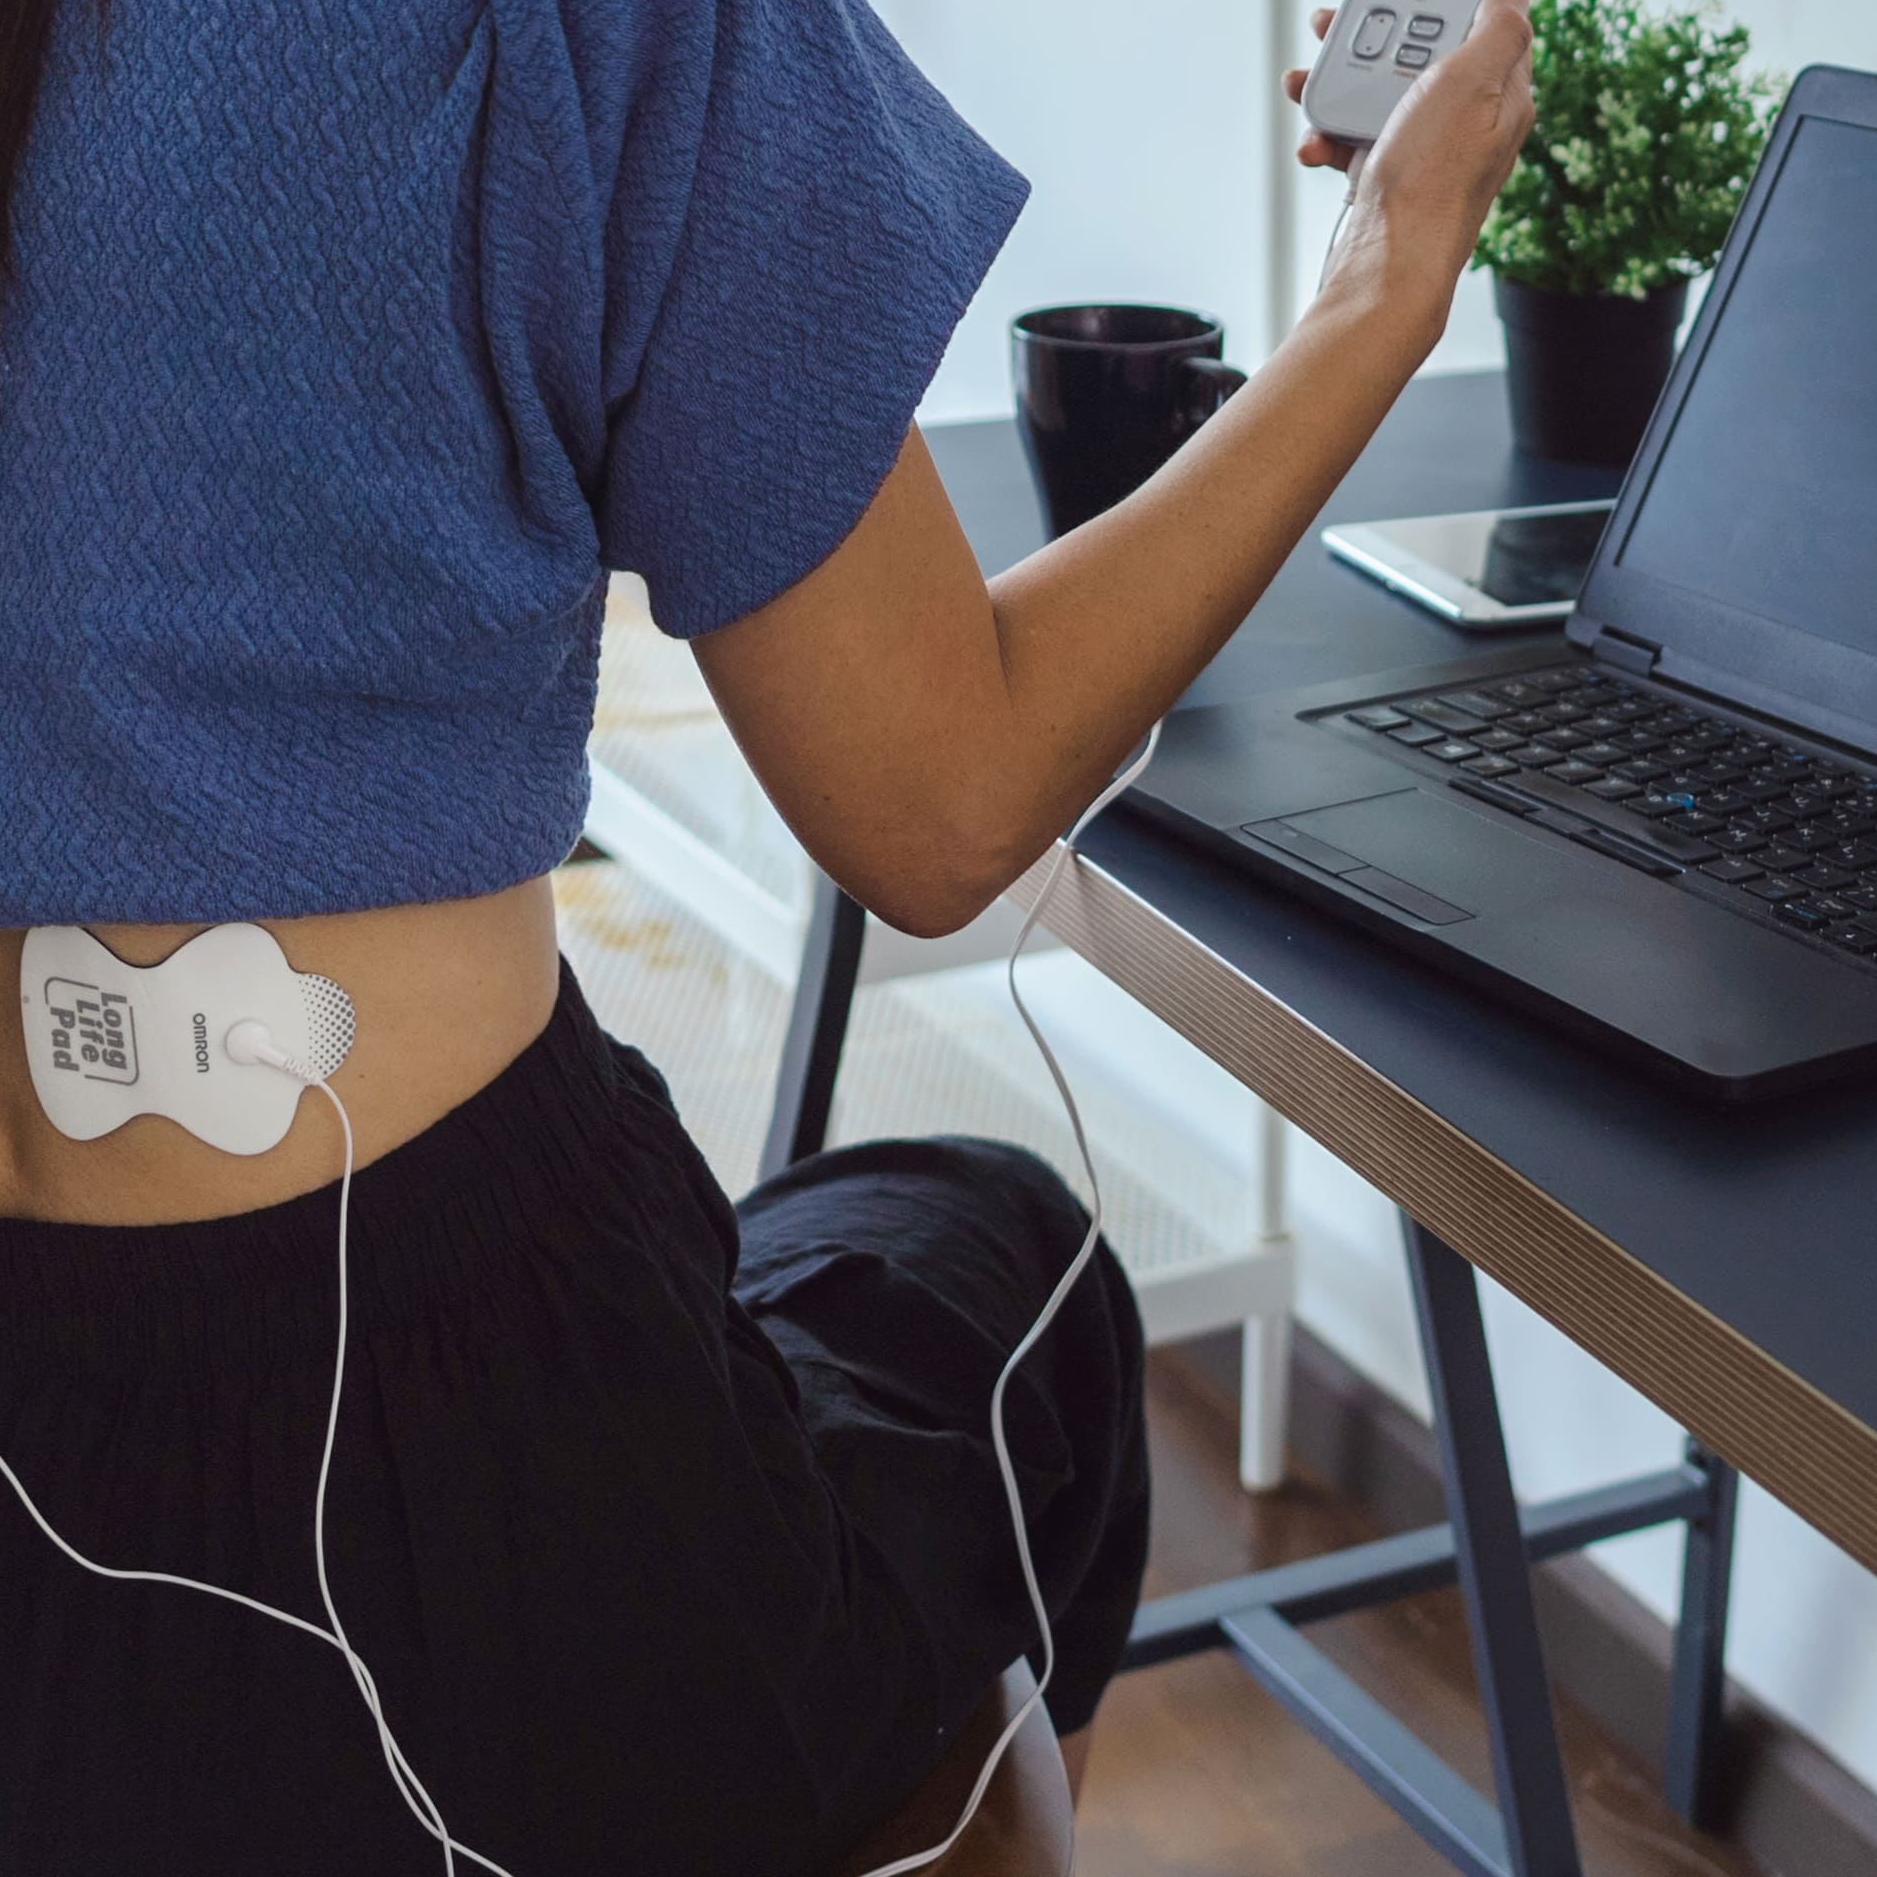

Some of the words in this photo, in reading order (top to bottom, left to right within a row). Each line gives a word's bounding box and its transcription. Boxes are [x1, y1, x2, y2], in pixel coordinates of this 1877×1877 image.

[50, 1006, 80, 1072] Pad
[76, 999, 105, 1063] Life
[101, 992, 128, 1070] Long
[192, 1012, 210, 1073] OMRON
